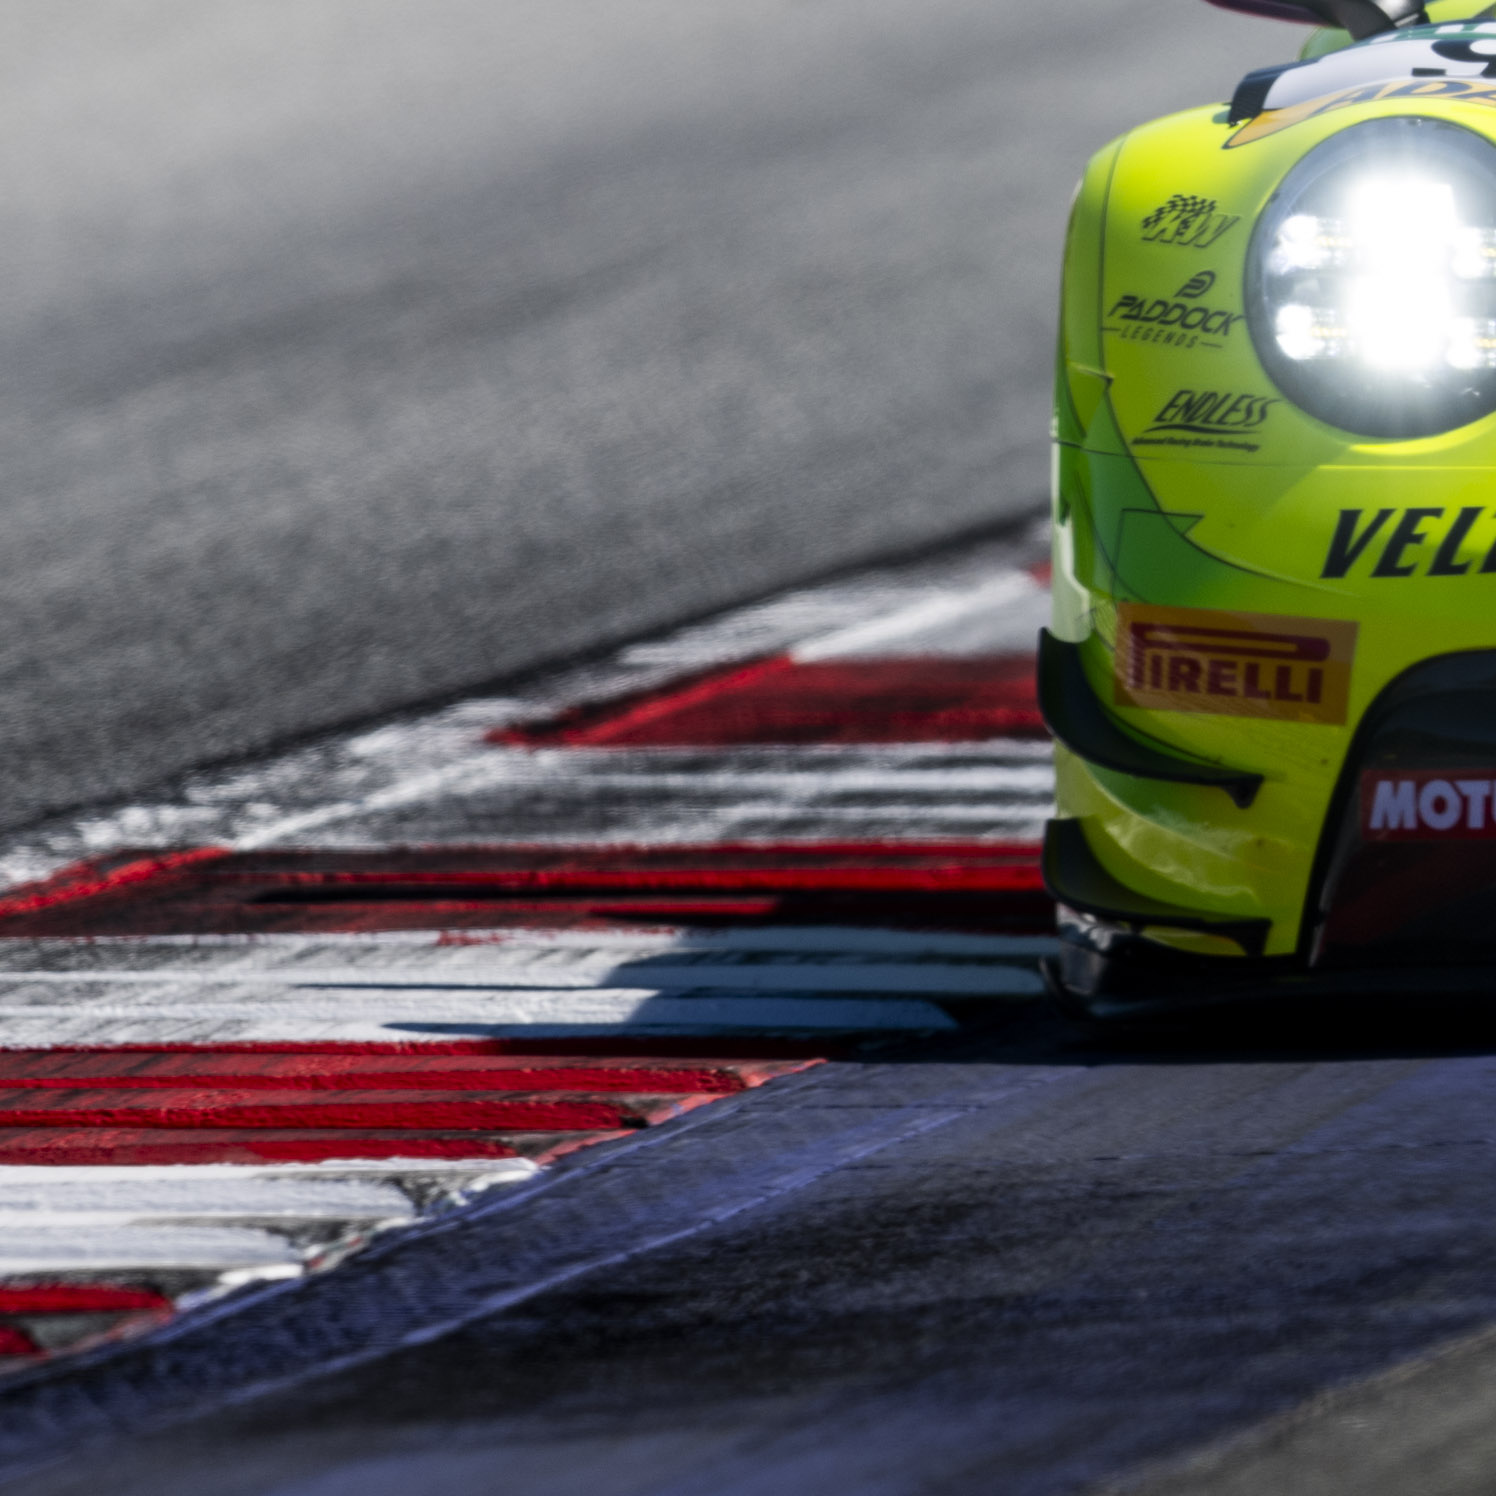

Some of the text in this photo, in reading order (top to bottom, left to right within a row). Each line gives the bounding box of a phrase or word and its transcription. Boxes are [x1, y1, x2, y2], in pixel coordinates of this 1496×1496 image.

[1108, 295, 1245, 336] PADDOCK
[1120, 324, 1200, 349] LEGENDS
[1154, 389, 1282, 427] ENDLESS
[1128, 621, 1331, 705] PIRELLI
